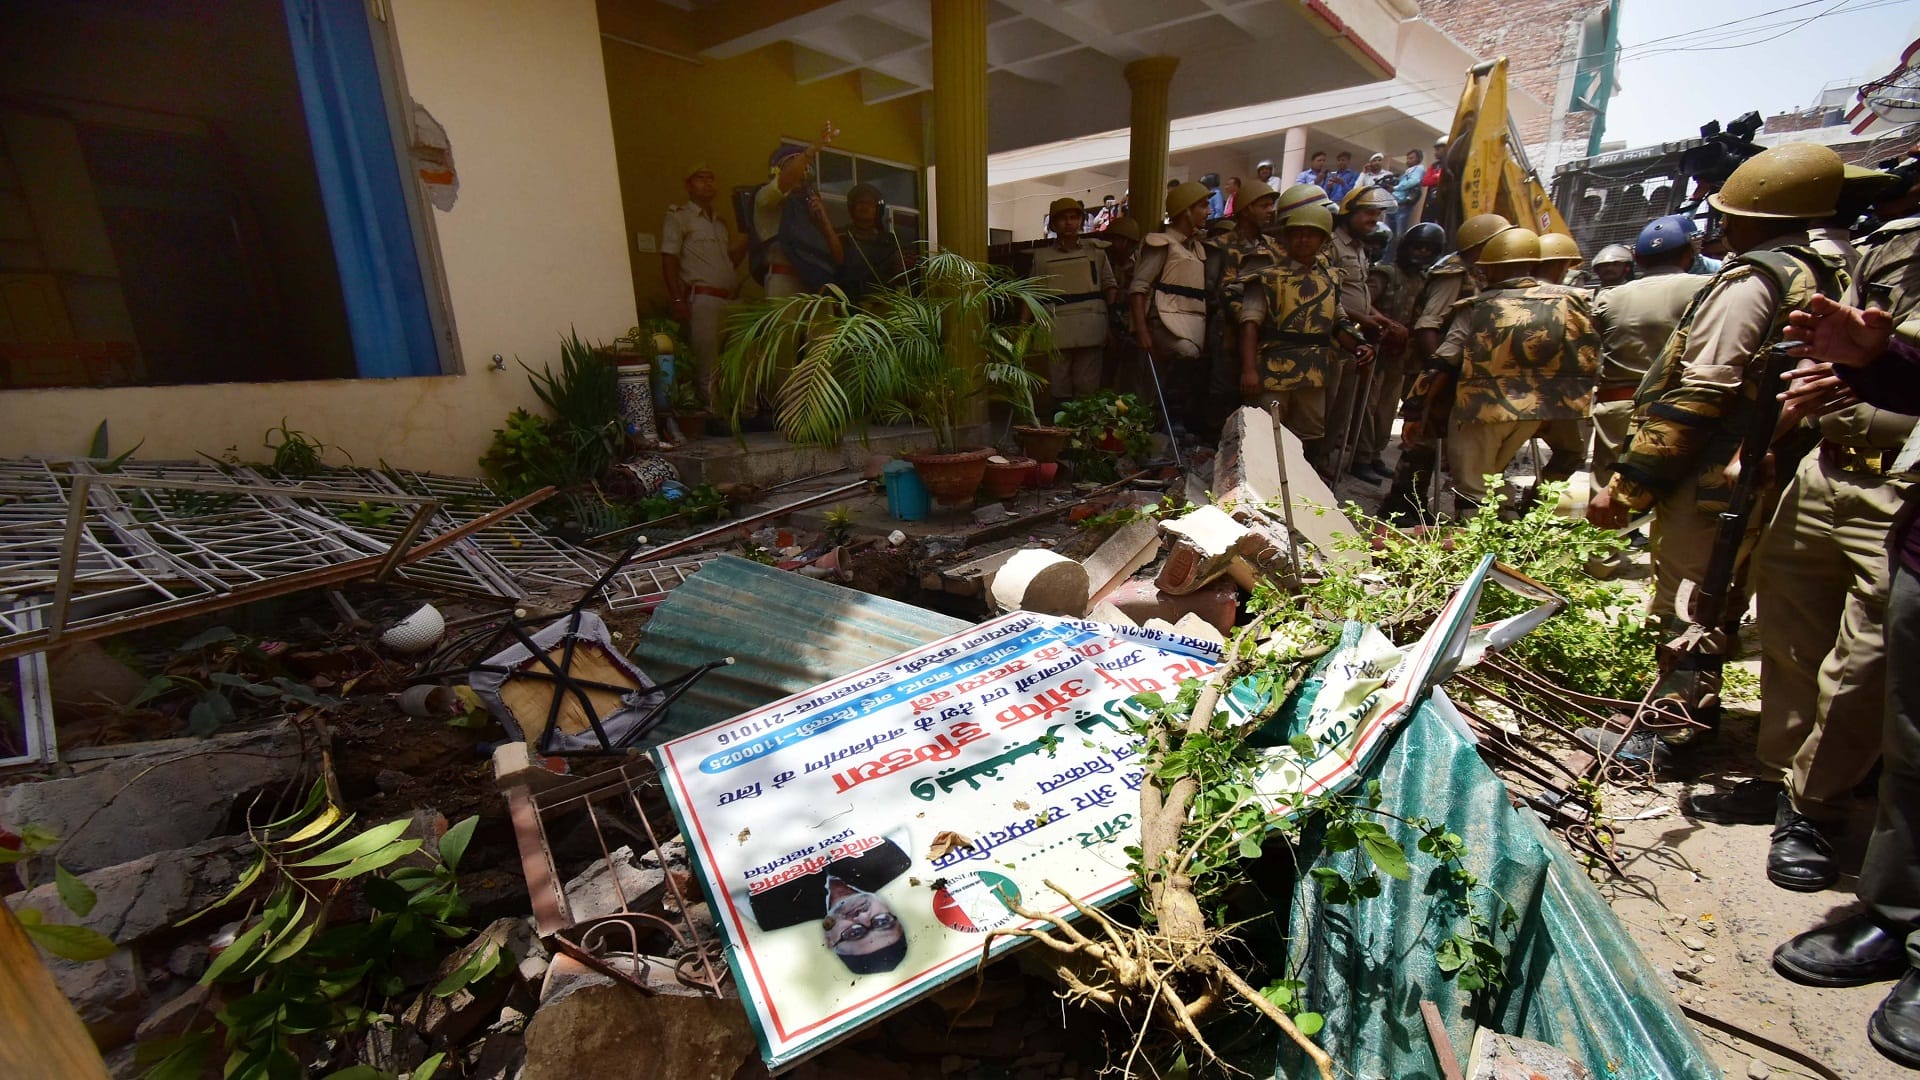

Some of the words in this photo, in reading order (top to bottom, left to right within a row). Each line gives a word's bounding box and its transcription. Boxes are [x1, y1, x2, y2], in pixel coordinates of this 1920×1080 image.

[953, 643, 1021, 673] जामिया
[1032, 646, 1064, 662] के
[956, 660, 1032, 693] सदस्य
[860, 692, 897, 713] नई
[910, 690, 955, 715] बनें
[980, 688, 1010, 706] एवं
[995, 678, 1093, 730] ऑफ
[913, 716, 937, 731] के
[940, 701, 977, 722] देश
[802, 726, 908, 775] नवनिर्माण
[771, 770, 797, 789] के
[1036, 756, 1115, 795] विकल्प
[716, 782, 764, 807] लिए
[1071, 784, 1117, 811] और
[818, 828, 856, 849] प्रदेश
[830, 835, 884, 863] जावेद
[744, 845, 817, 880] महासचिव
[749, 856, 829, 895] मोहम्मद
